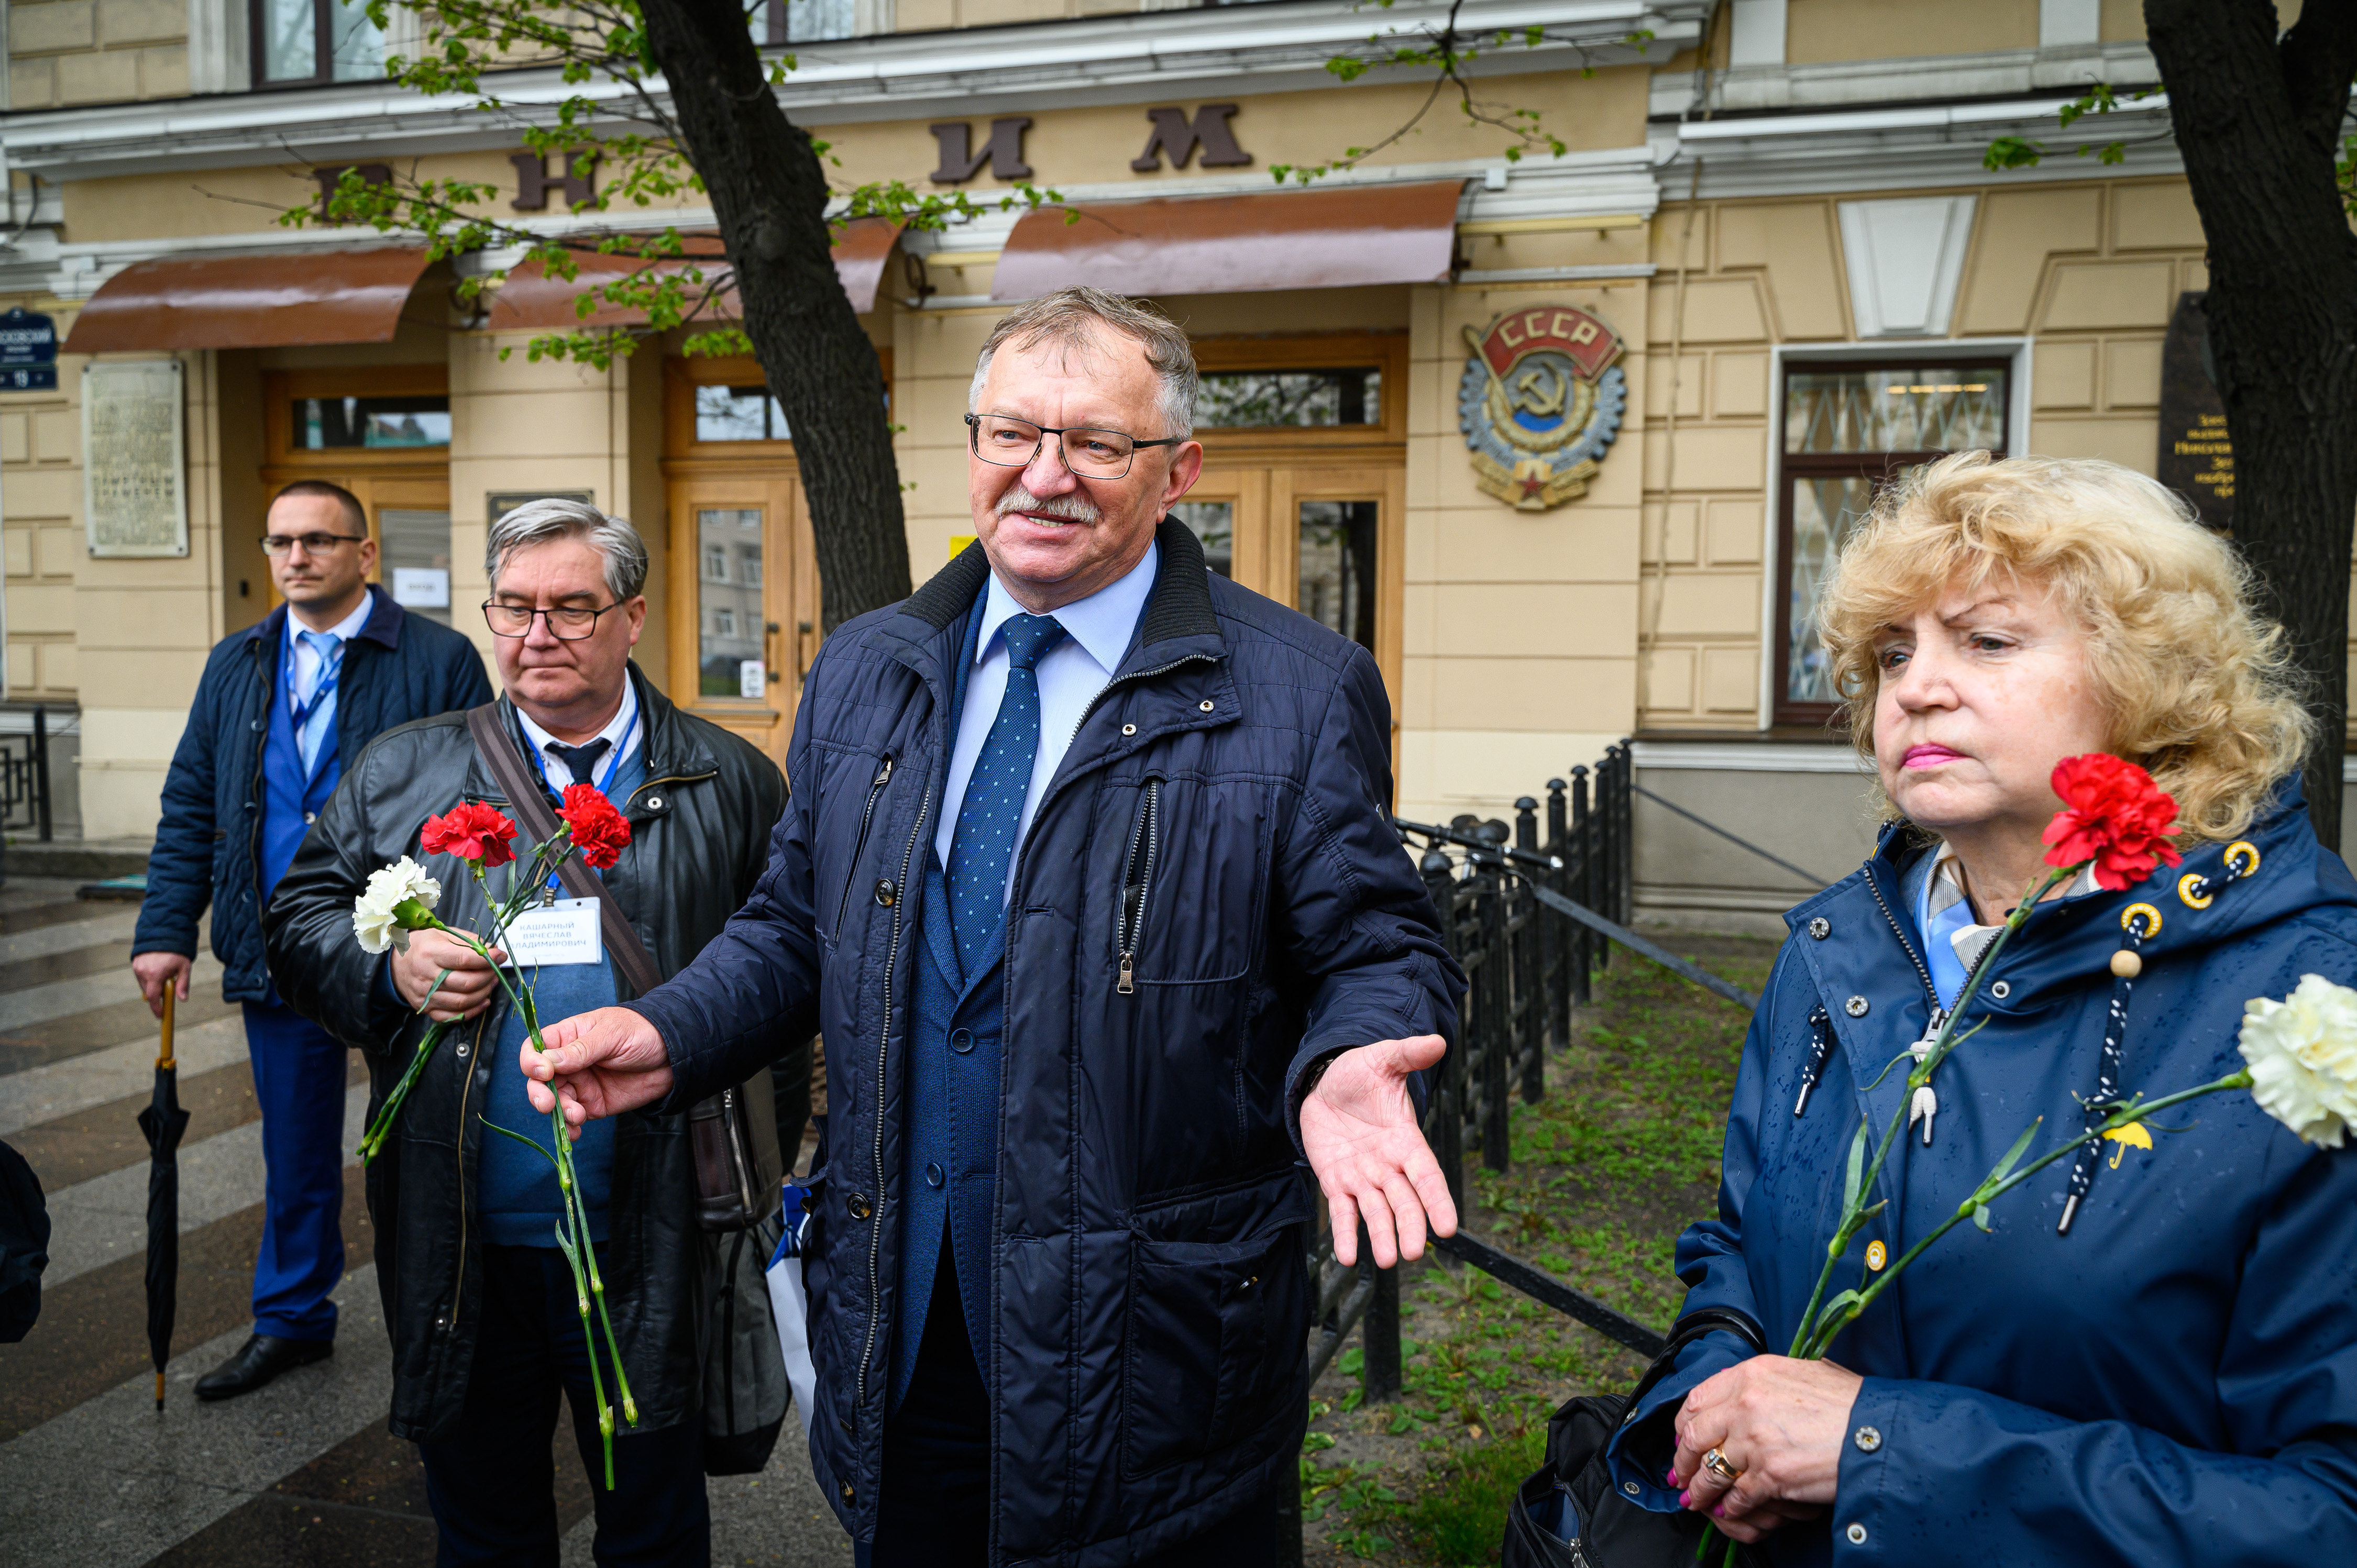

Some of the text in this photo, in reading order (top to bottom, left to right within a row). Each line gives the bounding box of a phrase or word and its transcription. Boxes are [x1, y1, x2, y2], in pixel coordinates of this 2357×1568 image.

[0, 326, 52, 345] СКОВСКИЙ
[1499, 311, 1599, 349] СССР
[13, 369, 29, 388] 19
[520, 922, 575, 931] КАШАРНЫЙ
